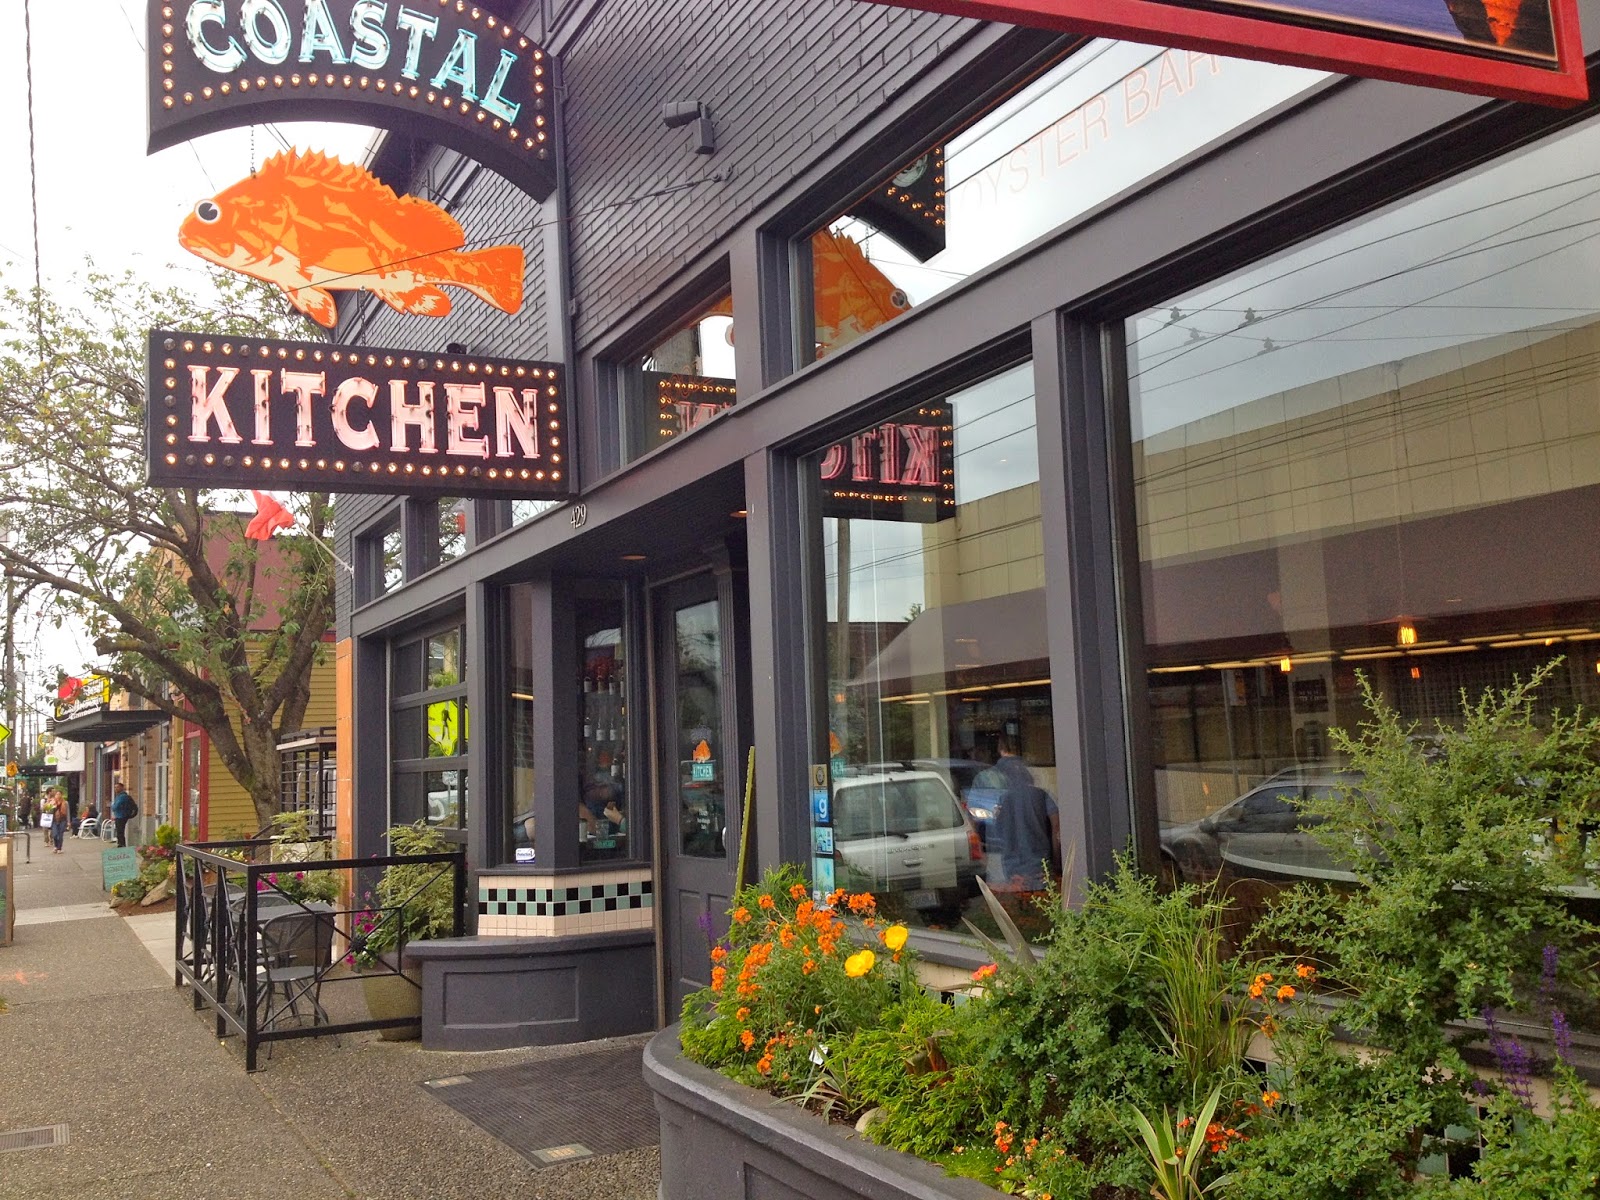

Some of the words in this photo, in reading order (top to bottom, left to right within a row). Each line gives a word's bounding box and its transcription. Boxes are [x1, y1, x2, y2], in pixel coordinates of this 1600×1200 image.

[185, 0, 521, 126] COASTAL
[960, 93, 1109, 211] OYSTER
[187, 364, 541, 459] KITCHEN
[570, 503, 587, 529] 429
